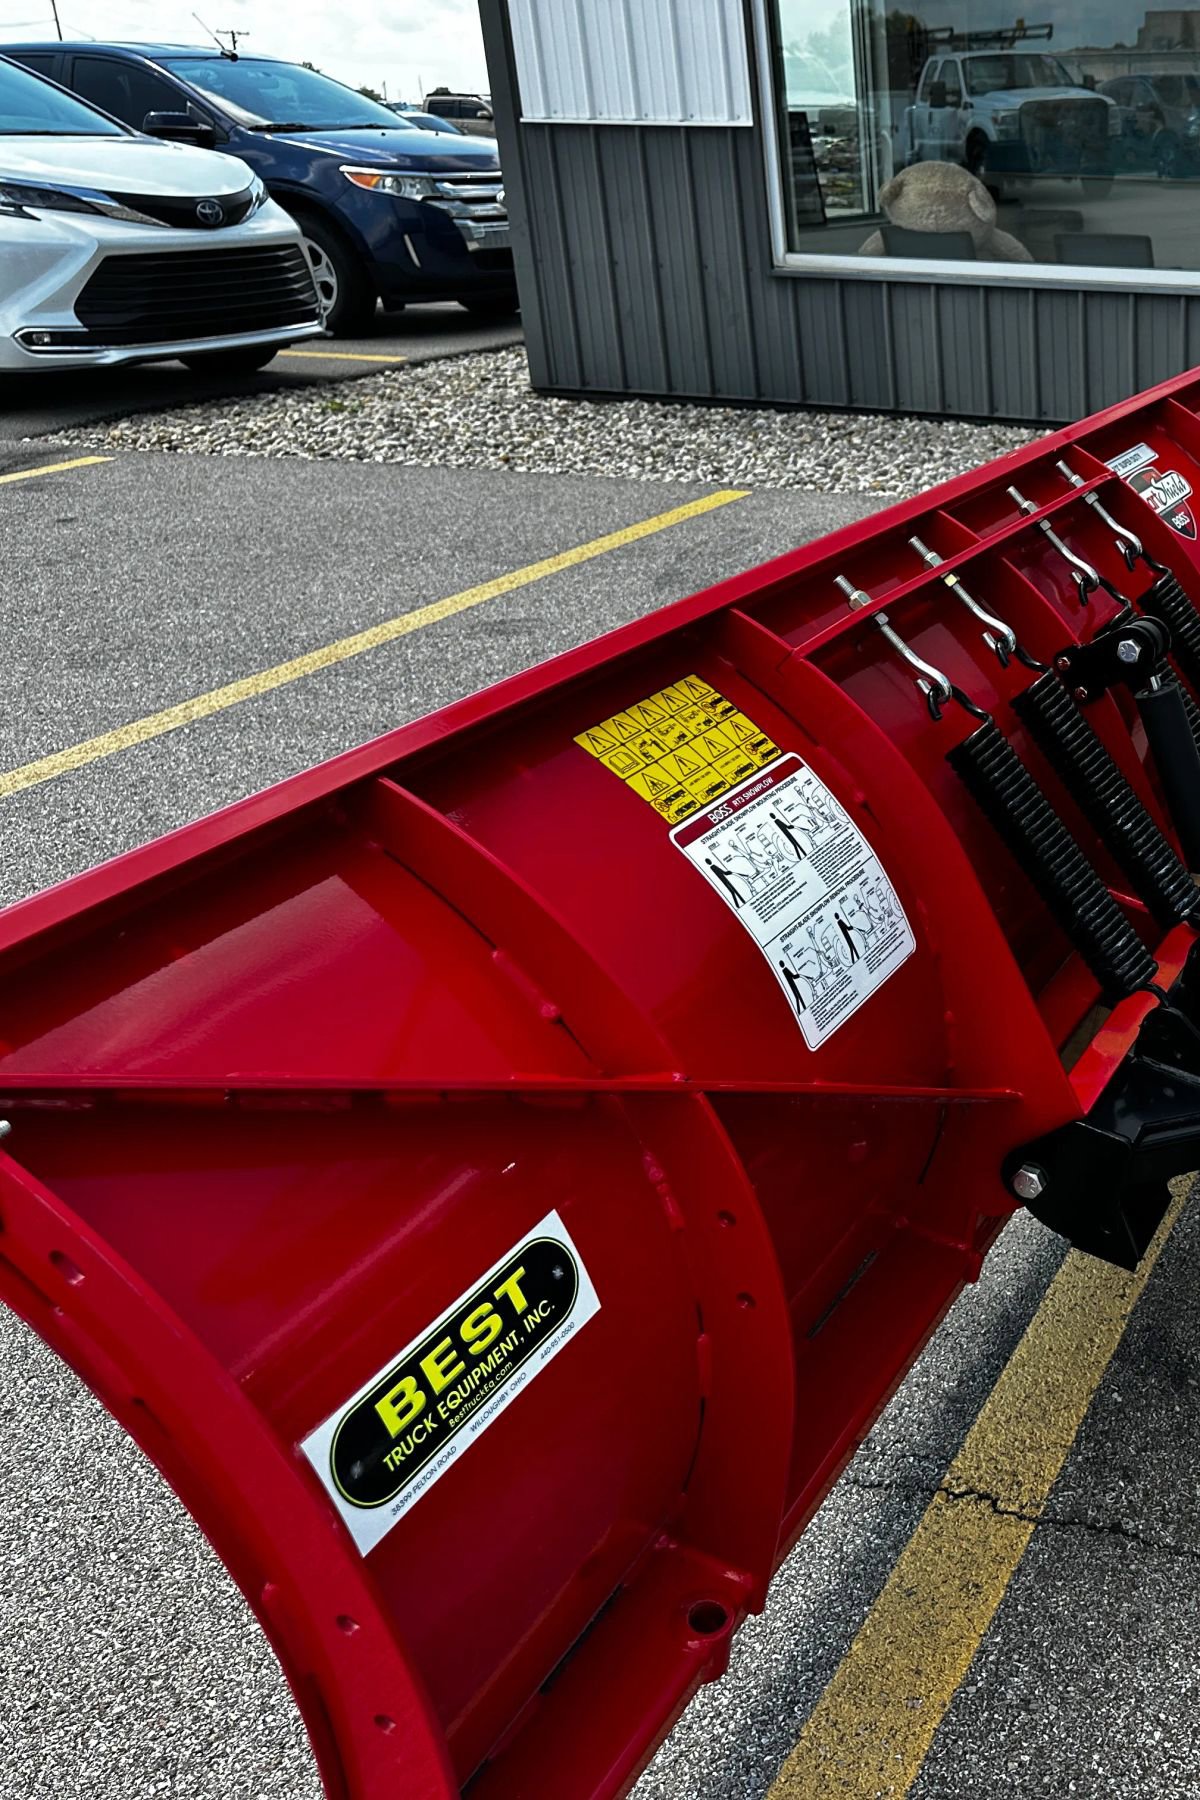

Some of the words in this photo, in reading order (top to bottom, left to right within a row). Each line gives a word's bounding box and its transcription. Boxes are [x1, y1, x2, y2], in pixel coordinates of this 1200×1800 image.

[700, 819, 735, 845] STRAIGHT-BLADE
[733, 803, 757, 822] SNOWPLOW
[755, 790, 777, 807] MOUNTING
[707, 803, 733, 824] BOSS
[732, 796, 745, 807] RT3
[742, 777, 774, 800] SNOWPLOW
[374, 1266, 528, 1438] BEST
[382, 1413, 438, 1472] TRUCK
[436, 1330, 525, 1420] EQUIPMENT,
[523, 1299, 556, 1333] INC.
[412, 1465, 437, 1494] PELTON
[436, 1445, 457, 1469] ROAD
[470, 1391, 509, 1432] WILLOUGHBY
[510, 1372, 527, 1392] OHIO
[540, 1321, 575, 1360] 440-951-0500
[448, 1361, 513, 1428] BestTruckEq.com
